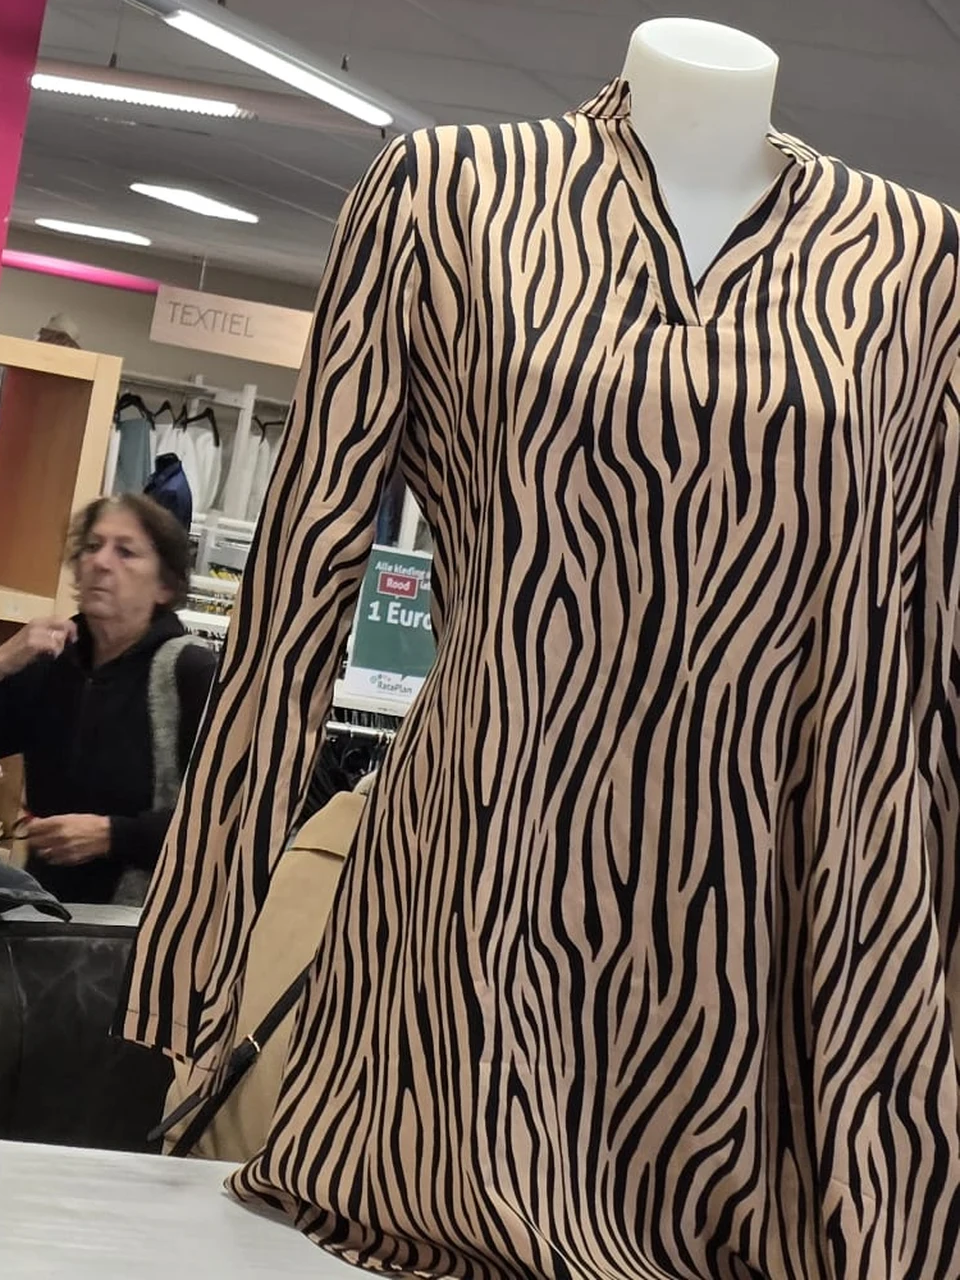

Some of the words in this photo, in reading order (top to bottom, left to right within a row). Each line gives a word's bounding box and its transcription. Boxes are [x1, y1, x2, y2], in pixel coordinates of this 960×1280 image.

[169, 300, 254, 338] TEXTIEL
[375, 561, 393, 572] Alle
[386, 578, 411, 592] Rood
[367, 600, 381, 622] 1
